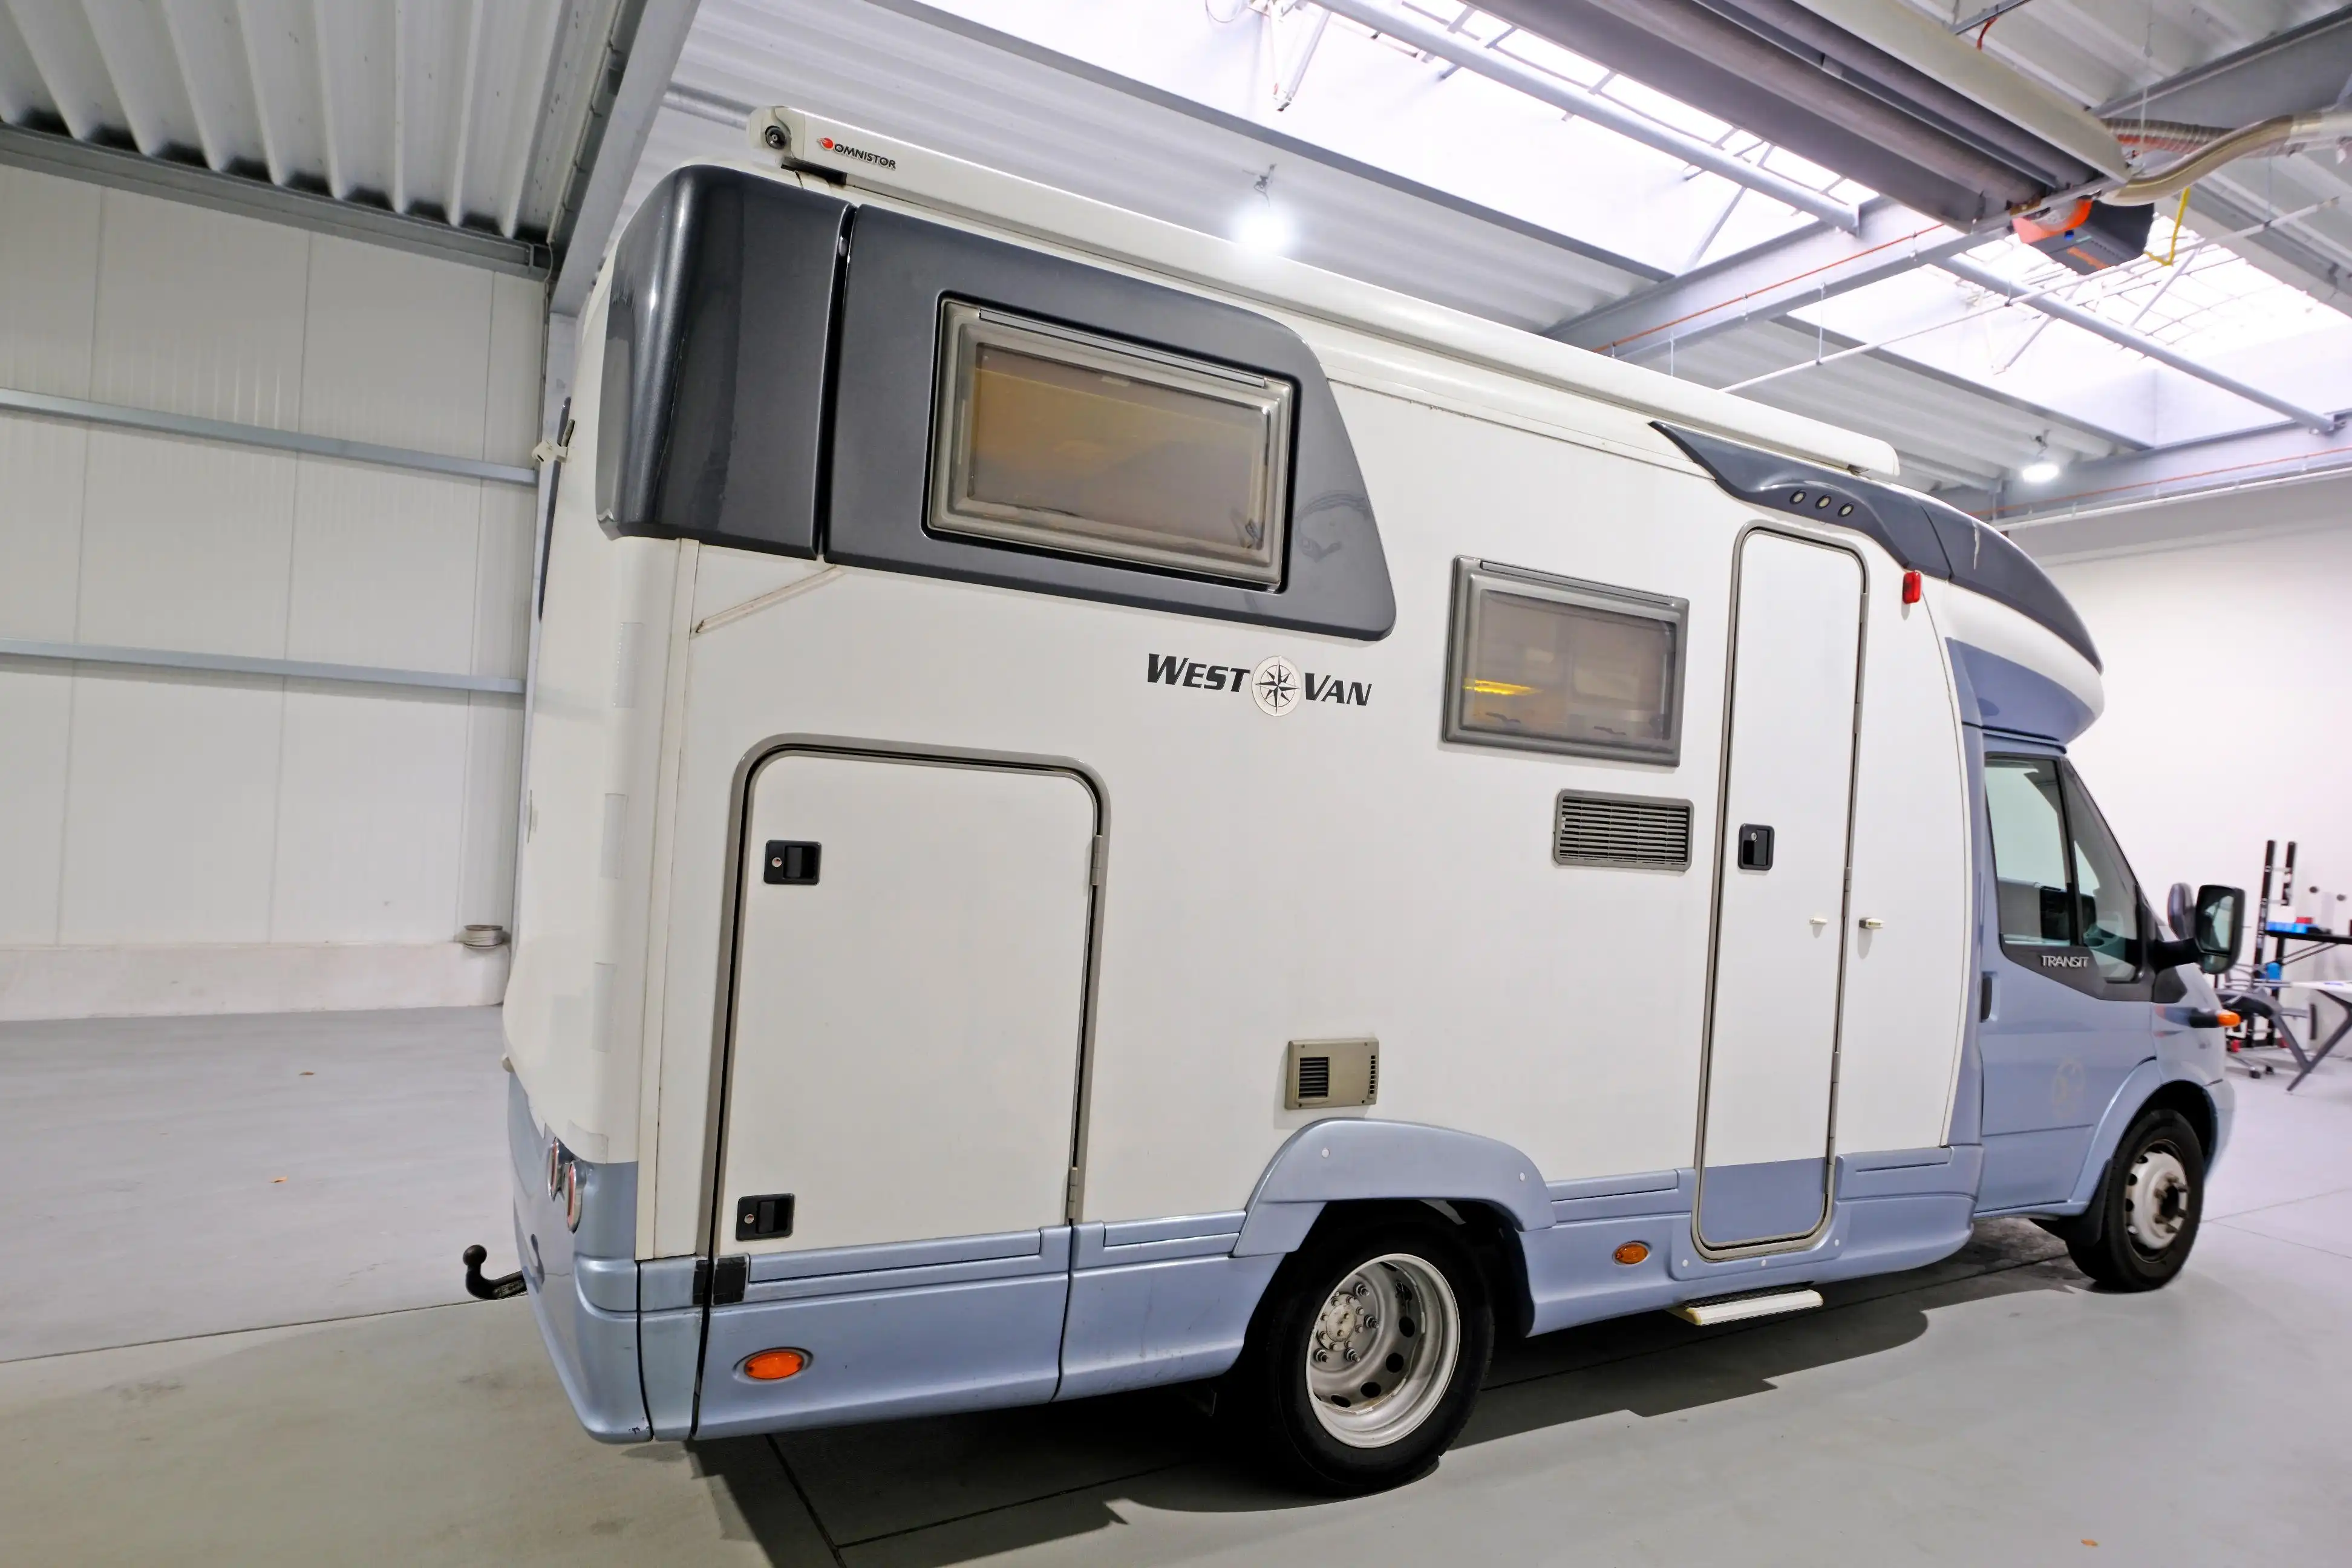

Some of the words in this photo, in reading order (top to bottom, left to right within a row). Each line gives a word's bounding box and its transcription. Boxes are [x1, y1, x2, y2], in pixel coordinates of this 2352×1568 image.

[834, 143, 897, 169] OMNISTOR
[1147, 653, 1250, 692] WEST
[1305, 673, 1372, 707] VAN
[2042, 955, 2089, 968] TRANSIT
